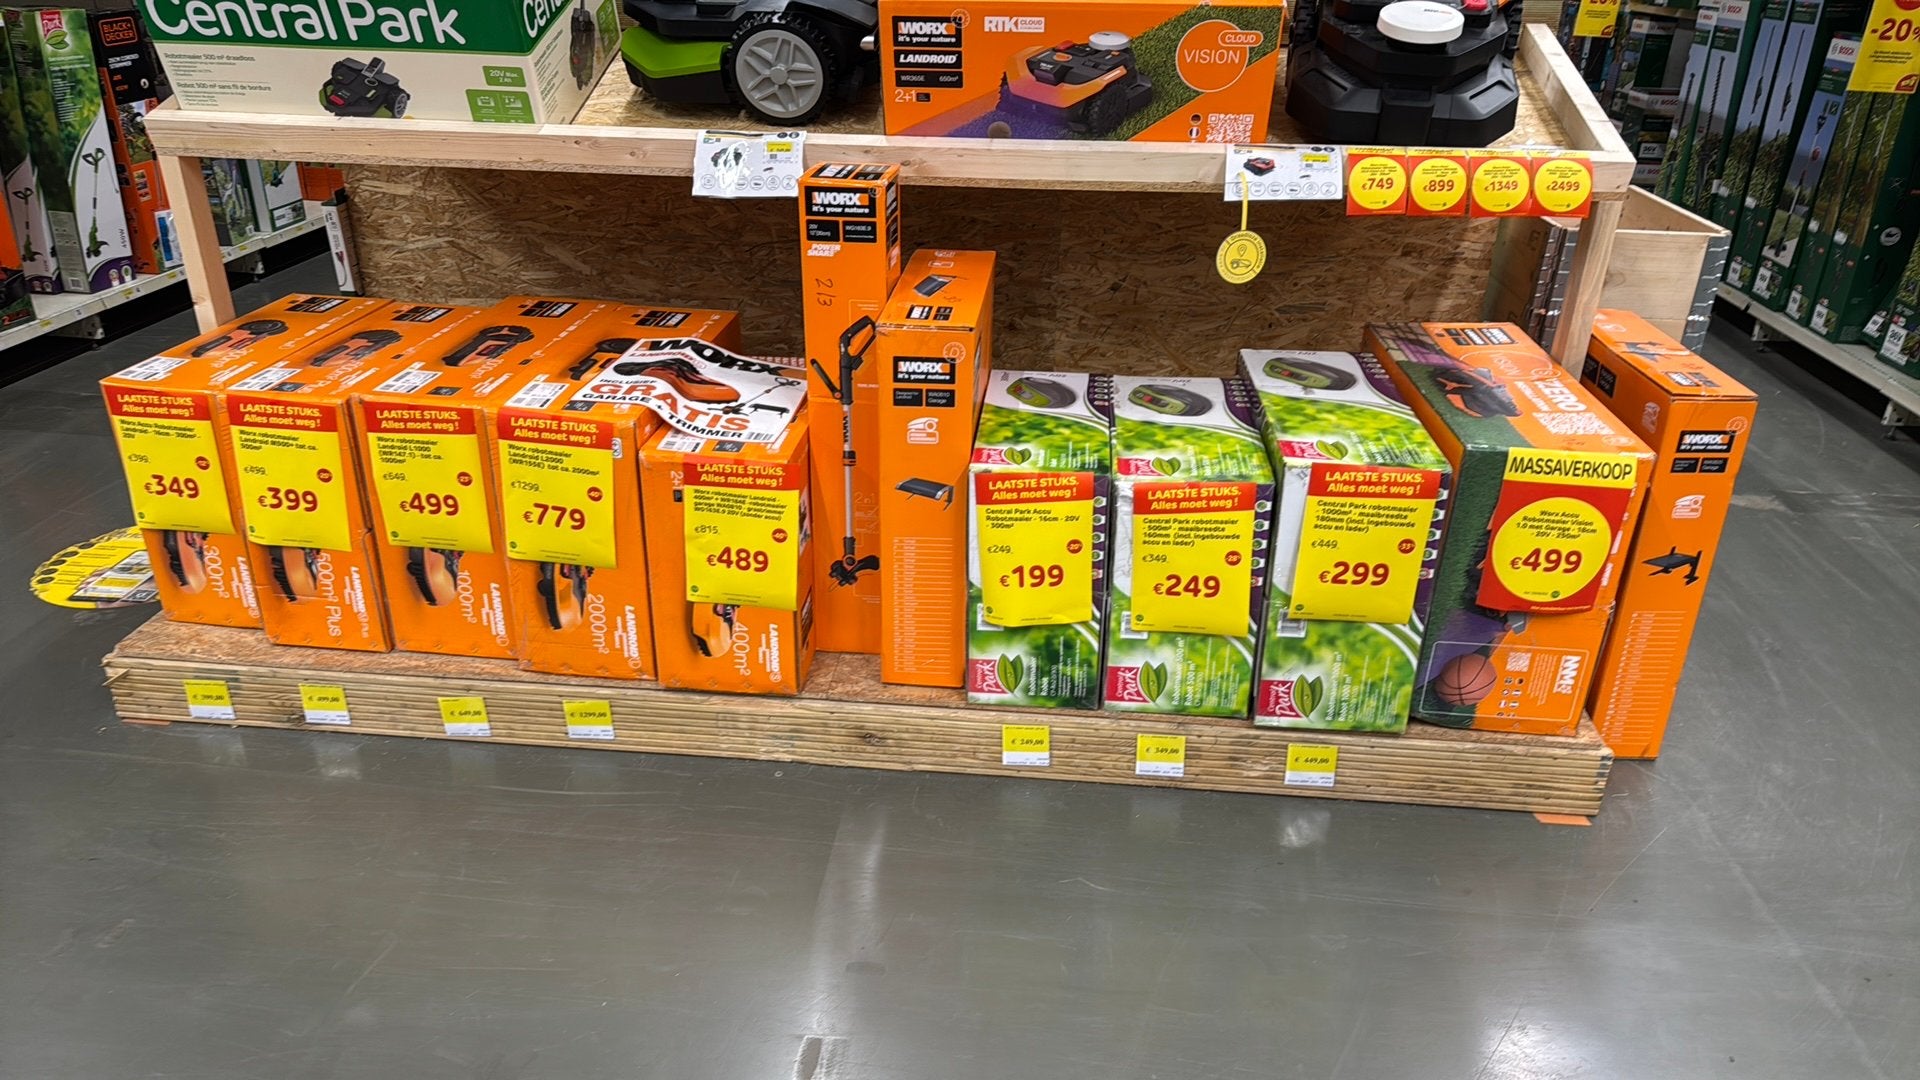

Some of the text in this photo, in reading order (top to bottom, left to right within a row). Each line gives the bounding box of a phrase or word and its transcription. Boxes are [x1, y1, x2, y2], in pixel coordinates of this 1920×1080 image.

[103, 24, 132, 33] BLACK+
[145, 0, 466, 45] Central Park
[899, 22, 948, 34] WORX
[984, 16, 1018, 32] RTK
[105, 31, 134, 41] DECKER
[912, 36, 929, 44] your
[1225, 34, 1256, 43] CLOUD
[899, 54, 957, 64] LANDROID
[1184, 49, 1240, 64] VISION
[895, 89, 916, 103] 2+1
[1362, 177, 1394, 191] €749
[1423, 178, 1455, 192] €899
[1484, 180, 1519, 192] €1349
[1546, 180, 1581, 192] €2499
[814, 191, 862, 205] WORX
[826, 206, 843, 214] your
[648, 339, 787, 376] WORX
[900, 361, 943, 373] WORX
[117, 394, 195, 406] LAATSTE STUKS.
[582, 392, 651, 404] GARAGE
[122, 404, 144, 413] Alles
[145, 406, 169, 415] moet
[240, 403, 322, 417] LAATSTE STUKS.
[376, 409, 460, 420] LAATSTE STUKS.
[590, 383, 751, 432] GRATIS
[243, 414, 267, 423] Alles
[269, 416, 294, 425] moet
[381, 420, 405, 430] Alles
[406, 421, 432, 430] moet
[510, 417, 599, 433] LAATSTE STUKS.
[667, 411, 744, 439] TRIMMER
[514, 428, 539, 438] Alles
[541, 431, 567, 441] moet
[1682, 434, 1724, 444] WORX
[697, 463, 785, 476] LAATSTE STUKS.
[1509, 456, 1633, 481] MASSAVERKOOP
[700, 473, 725, 483] Alles
[727, 476, 754, 485] moet
[989, 476, 1079, 490] LAATSTE STUKS.
[1325, 471, 1424, 483] LAATSTE STUKS.
[144, 474, 200, 498] €349
[1147, 486, 1242, 500] LAATSTE STUKS.
[1327, 483, 1355, 493] Alles
[1357, 484, 1388, 494] moet
[258, 486, 318, 512] €399
[992, 491, 1018, 501] Alles
[1020, 489, 1047, 499] moet
[400, 492, 459, 516] €499
[1151, 500, 1177, 510] Alles
[1179, 499, 1207, 509] moet
[523, 502, 586, 530] €779
[1143, 517, 1171, 525] Central
[1172, 517, 1190, 525] Park
[1193, 532, 1240, 541] ingebouwde
[707, 546, 769, 572] €489
[1510, 547, 1583, 574] €499
[203, 545, 230, 599] 300m²
[1000, 564, 1065, 588] €199
[1318, 560, 1390, 587] €299
[236, 555, 258, 608] LANDROID
[1153, 573, 1221, 598] €249
[350, 566, 366, 613] LANDROID
[456, 569, 478, 624] 1000m²
[489, 582, 506, 635] LANDROID
[324, 605, 343, 637] Plus
[587, 593, 610, 654] 2000m²
[624, 604, 640, 657] LANDROID
[732, 621, 752, 676] 400m²
[768, 623, 780, 672] LANDROID
[983, 660, 1002, 692] Park
[1123, 667, 1144, 701] Park
[1275, 681, 1297, 717] Park
